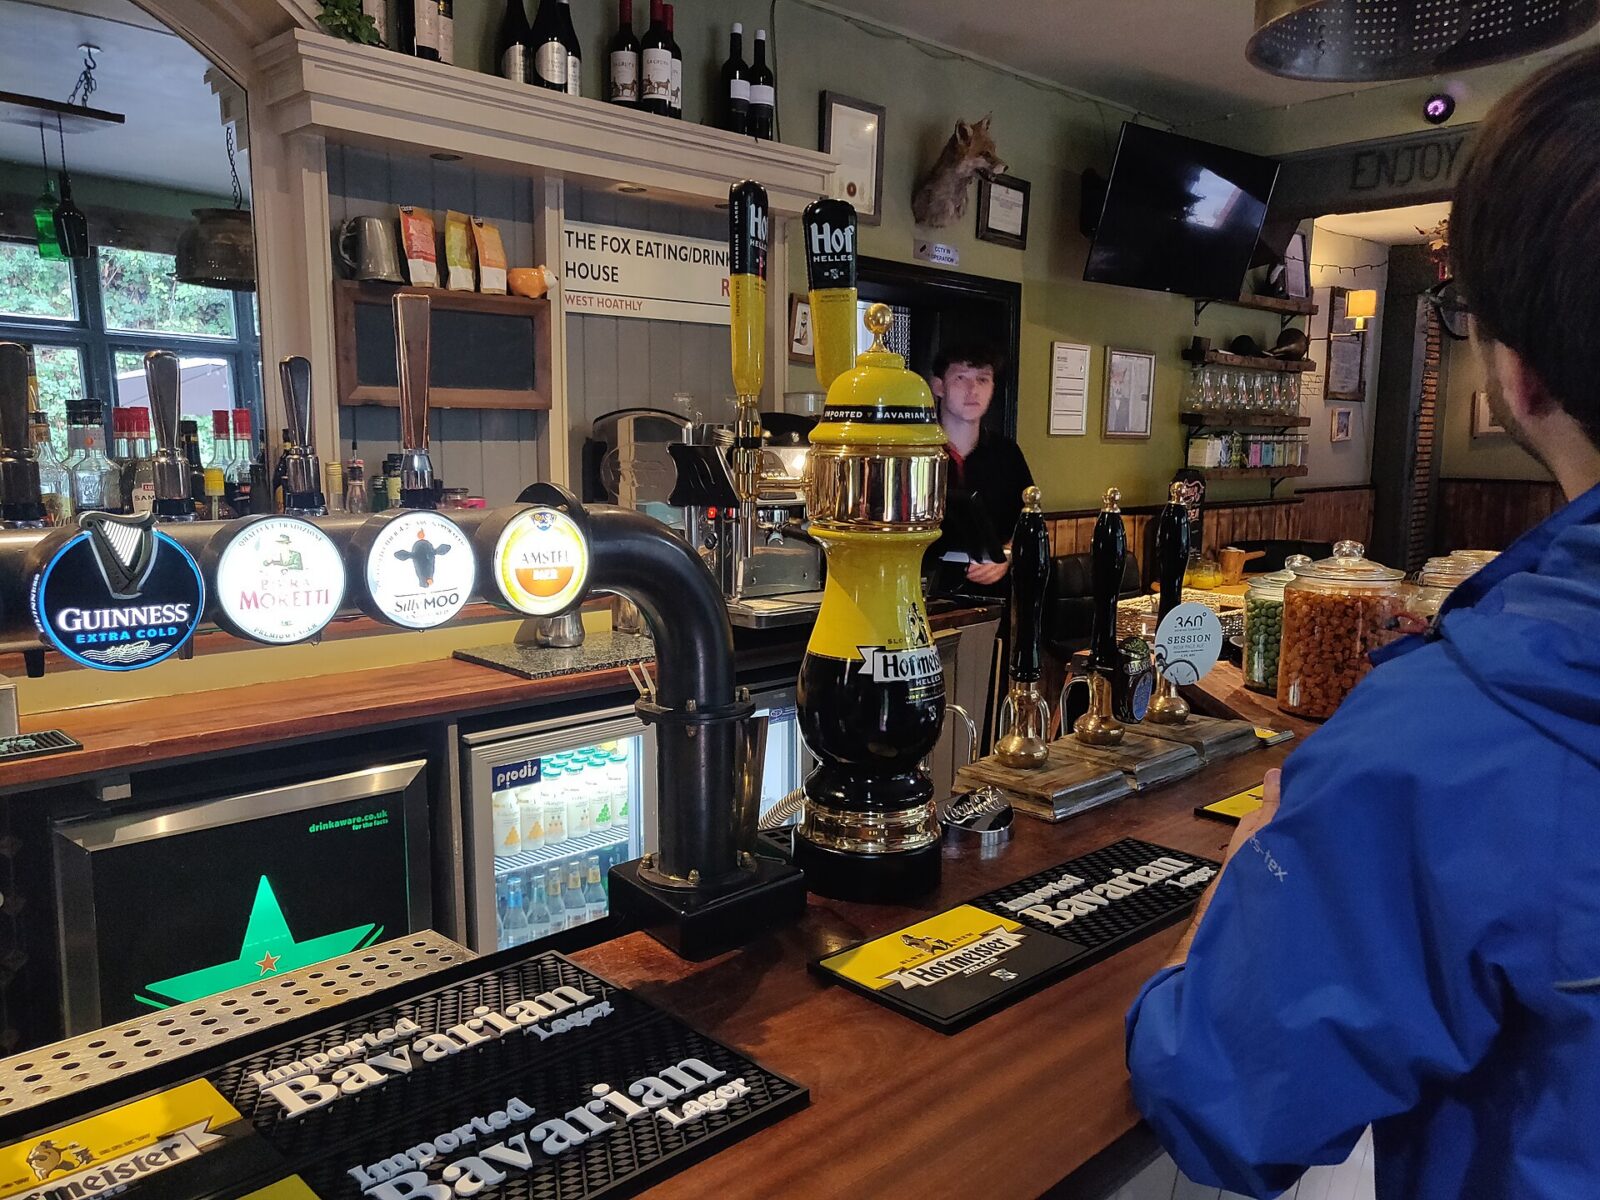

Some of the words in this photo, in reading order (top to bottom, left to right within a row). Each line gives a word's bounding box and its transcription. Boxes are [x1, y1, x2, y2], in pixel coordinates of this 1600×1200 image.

[1349, 137, 1464, 190] ENJOY
[750, 204, 768, 240] Ho
[564, 230, 596, 250] THE
[601, 235, 631, 255] FOX
[810, 222, 854, 254] Hof
[565, 260, 619, 282] HOUSE
[813, 254, 853, 262] HELLES
[564, 294, 593, 307] WEST
[597, 298, 643, 311] HOATHLY
[240, 588, 329, 610] MORETTI
[424, 593, 459, 609] MOO
[56, 604, 190, 631] GUINNESS
[76, 631, 131, 644] EXTRA
[135, 627, 178, 639] COLD
[1167, 634, 1211, 644] SESSION
[915, 675, 941, 685] HELLES
[496, 761, 537, 788] prodis
[308, 810, 388, 833] drinkaware.co.uk
[995, 873, 1086, 912] Imported
[1017, 857, 1194, 929] Bavarian
[1164, 866, 1218, 889] Lager
[908, 937, 1012, 982] Hofmeister
[963, 957, 999, 975] HELLES
[249, 1017, 422, 1089] Imported
[264, 985, 596, 1118] Bavarian
[527, 1000, 616, 1041] Lager
[656, 1077, 752, 1128] Lager
[346, 1096, 536, 1192] Imported
